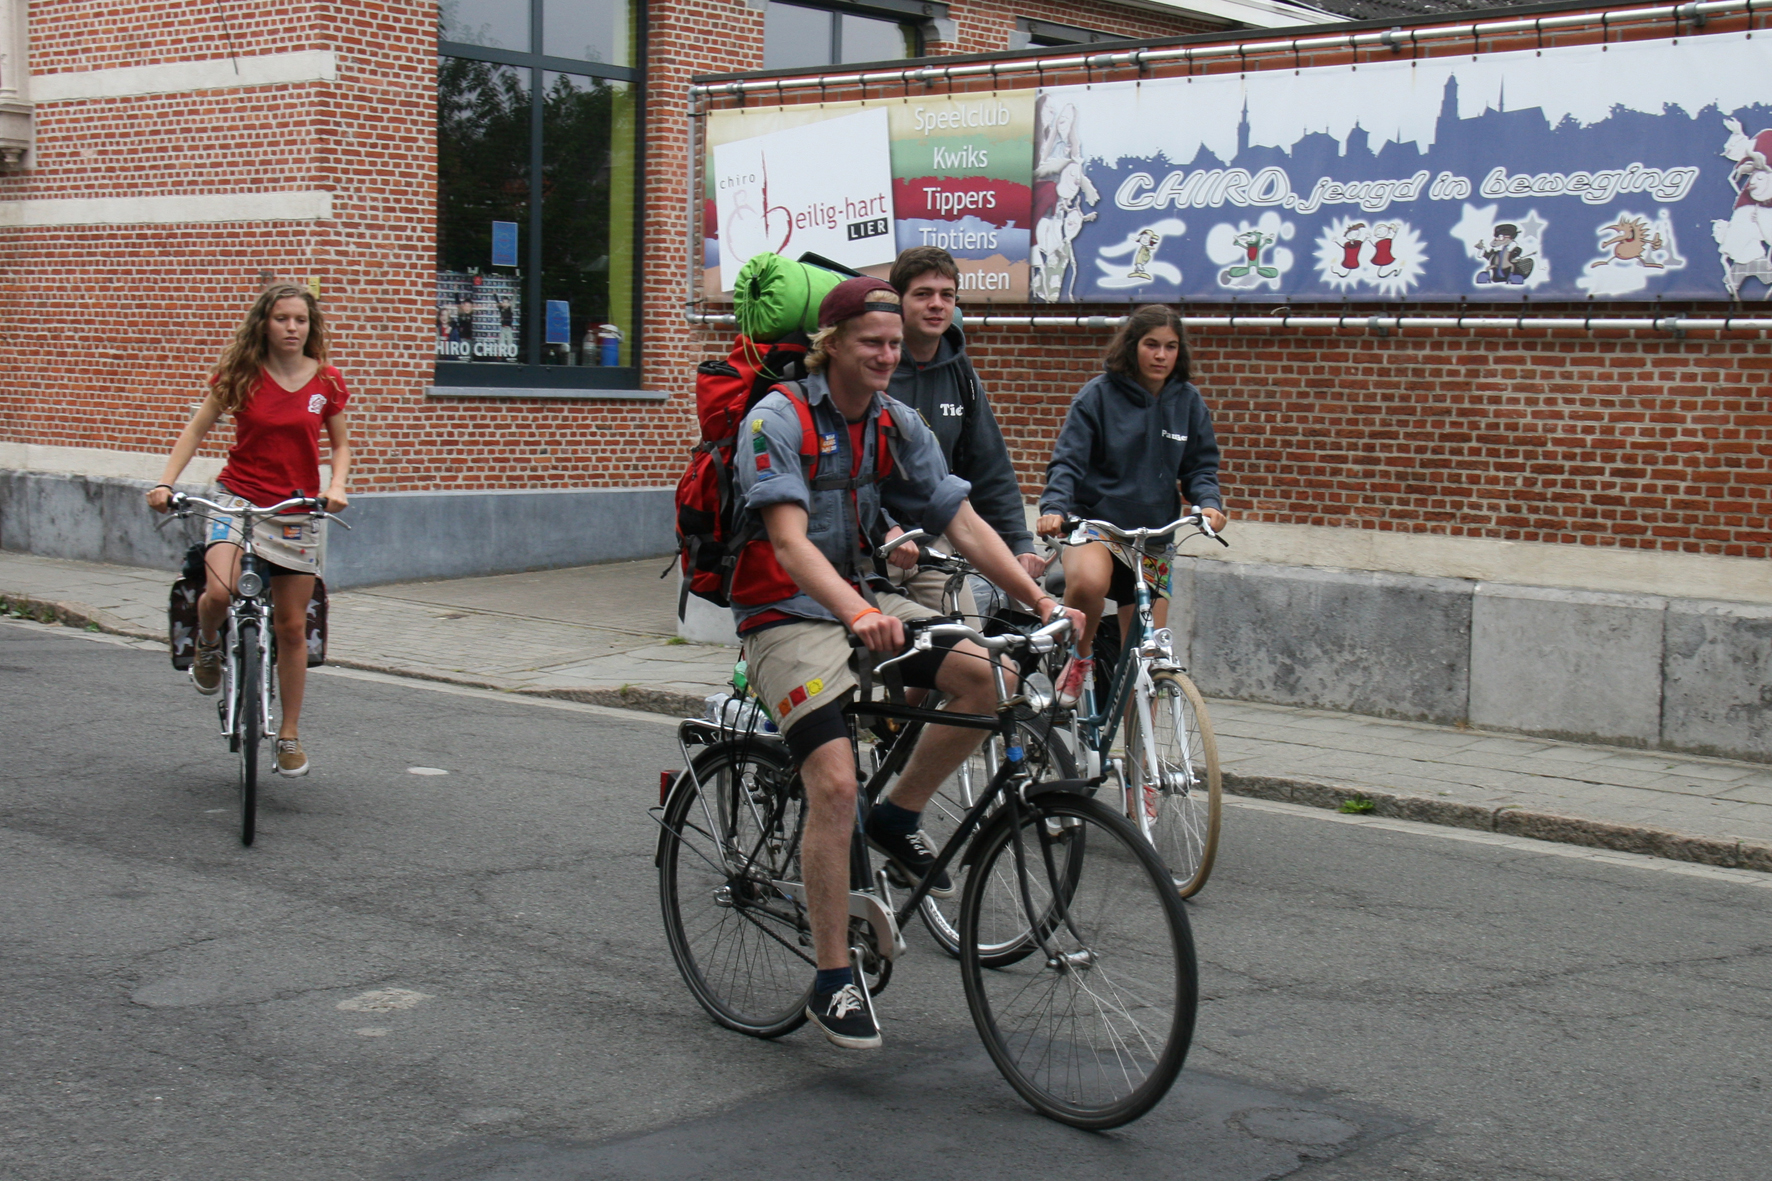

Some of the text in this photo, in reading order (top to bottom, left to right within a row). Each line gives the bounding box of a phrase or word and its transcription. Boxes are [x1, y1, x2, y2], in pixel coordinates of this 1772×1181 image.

[914, 102, 1010, 135] Speelclub
[933, 145, 988, 169] Kwiks
[719, 172, 756, 189] chiro
[1115, 162, 1699, 213] CHIRO, jeugd in beweging
[922, 187, 996, 215] Tippers
[850, 220, 887, 238] LIER
[957, 269, 1010, 290] anten
[435, 340, 471, 356] HIRO
[474, 341, 519, 357] CHIRO
